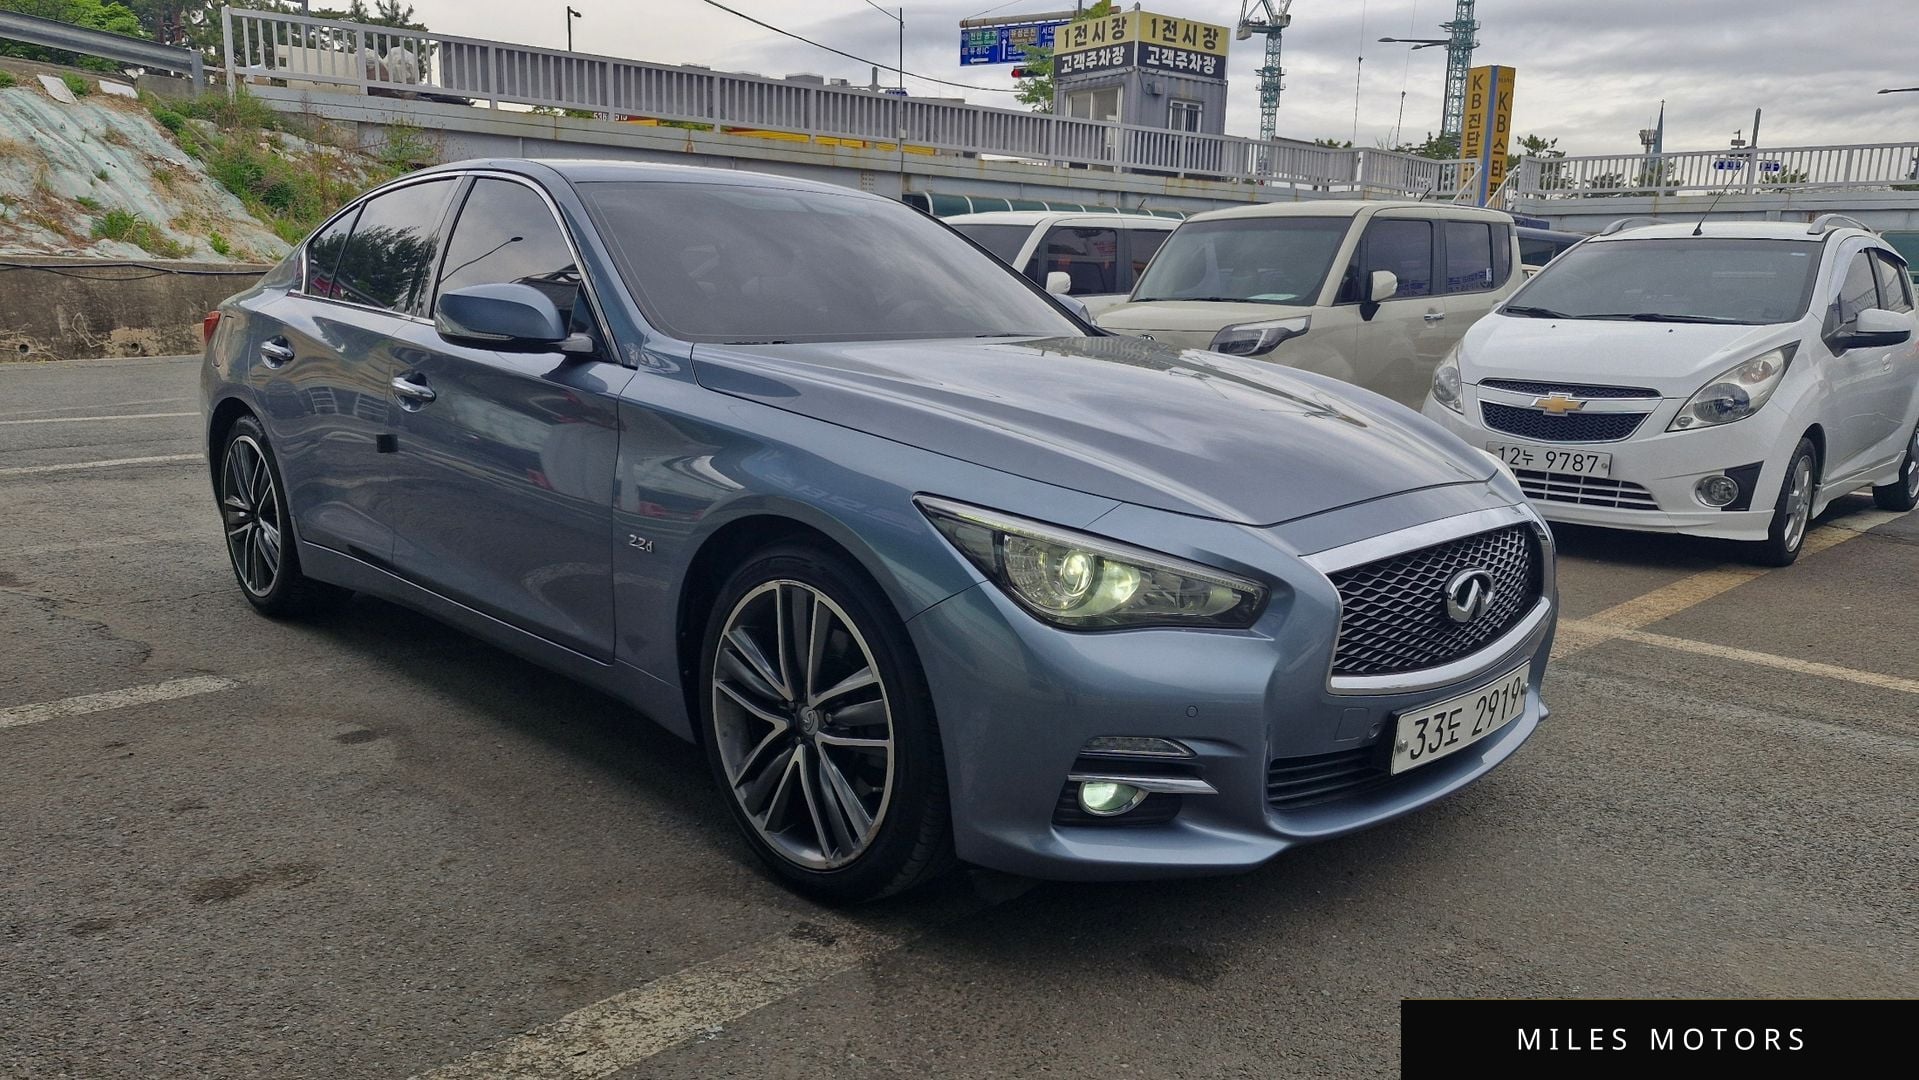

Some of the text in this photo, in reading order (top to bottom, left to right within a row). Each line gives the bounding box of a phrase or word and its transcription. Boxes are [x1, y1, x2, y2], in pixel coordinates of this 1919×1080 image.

[1064, 16, 1127, 48] 1전시장
[1151, 17, 1219, 50] 1전시장
[1061, 46, 1125, 74] 고객주차장
[1147, 46, 1216, 75] 고객주차장
[1498, 446, 1599, 473] 12누 9787
[1410, 676, 1521, 760] 33도 2919
